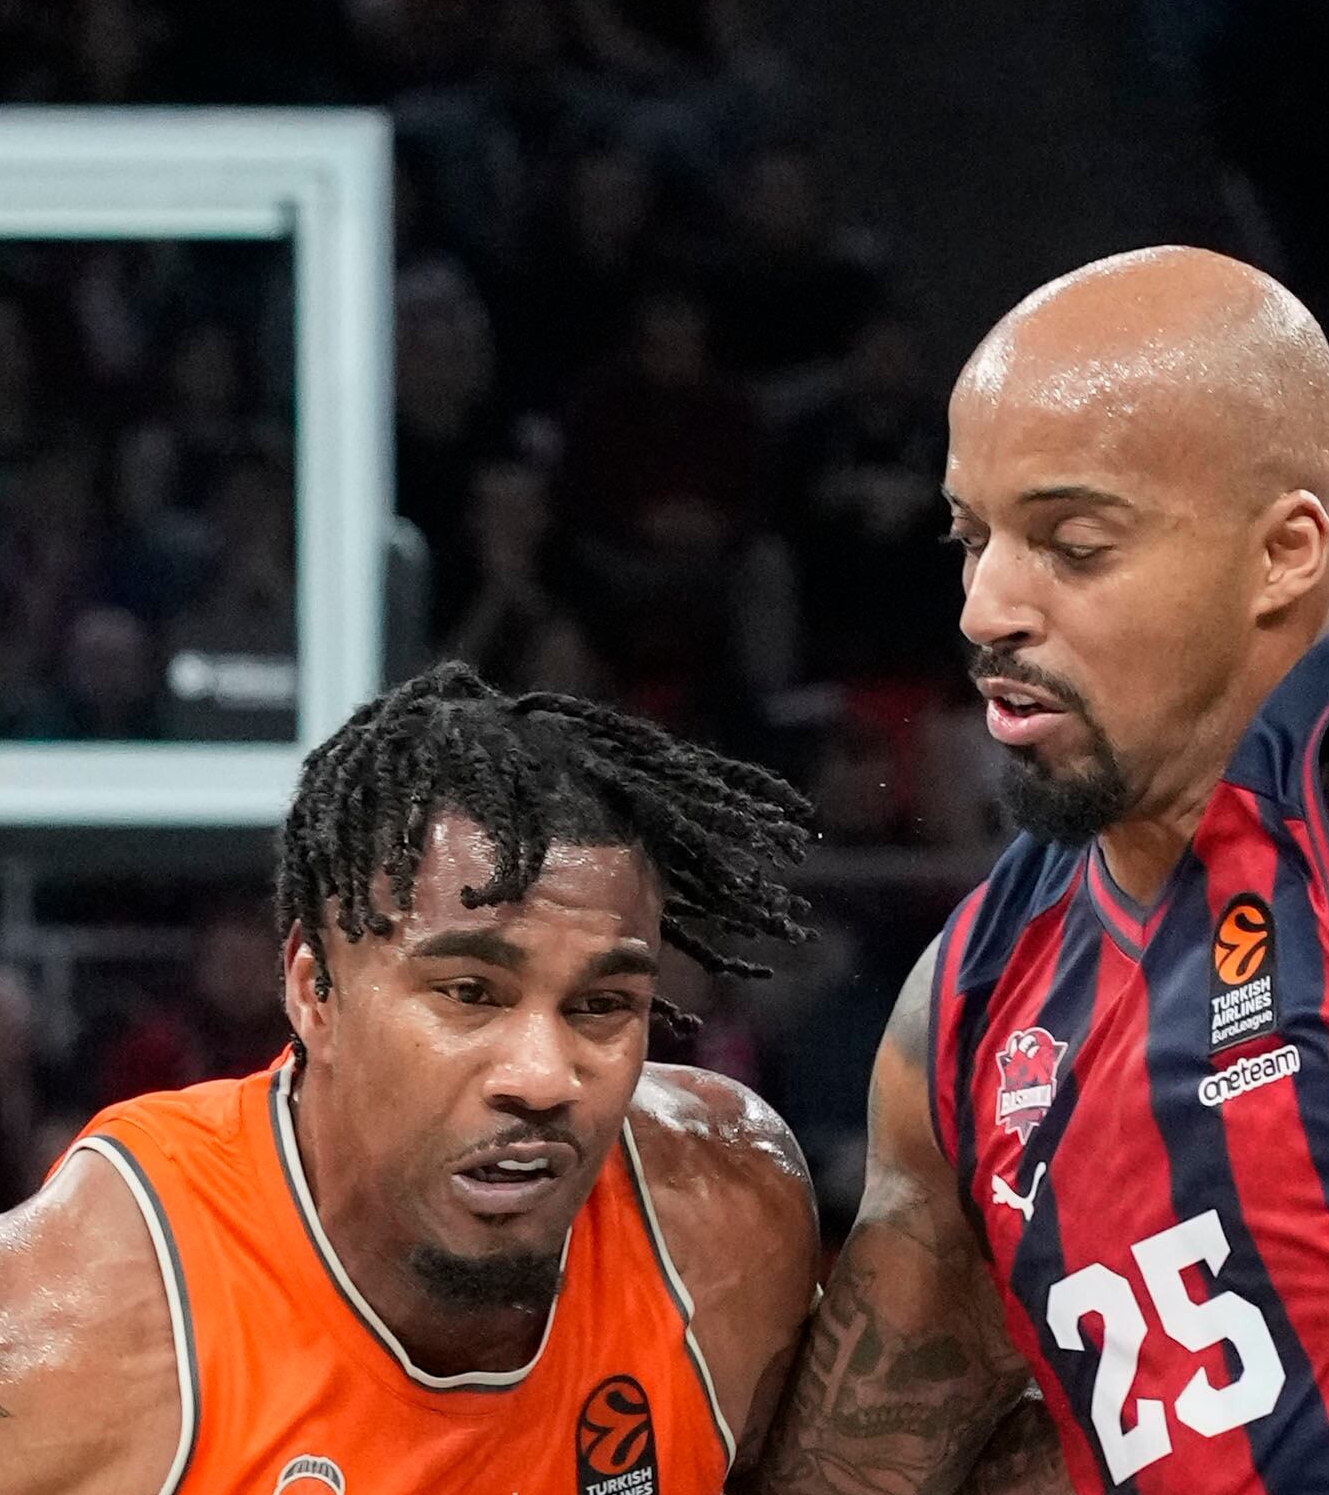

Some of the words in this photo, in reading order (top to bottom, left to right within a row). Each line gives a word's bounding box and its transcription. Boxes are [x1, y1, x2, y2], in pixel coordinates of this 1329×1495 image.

[1210, 975, 1271, 1013] TURKISH
[1211, 992, 1272, 1030] AIRLINES
[1211, 1010, 1273, 1044] EuroLeague
[1203, 1048, 1298, 1102] oneteam
[1046, 1208, 1286, 1487] 25
